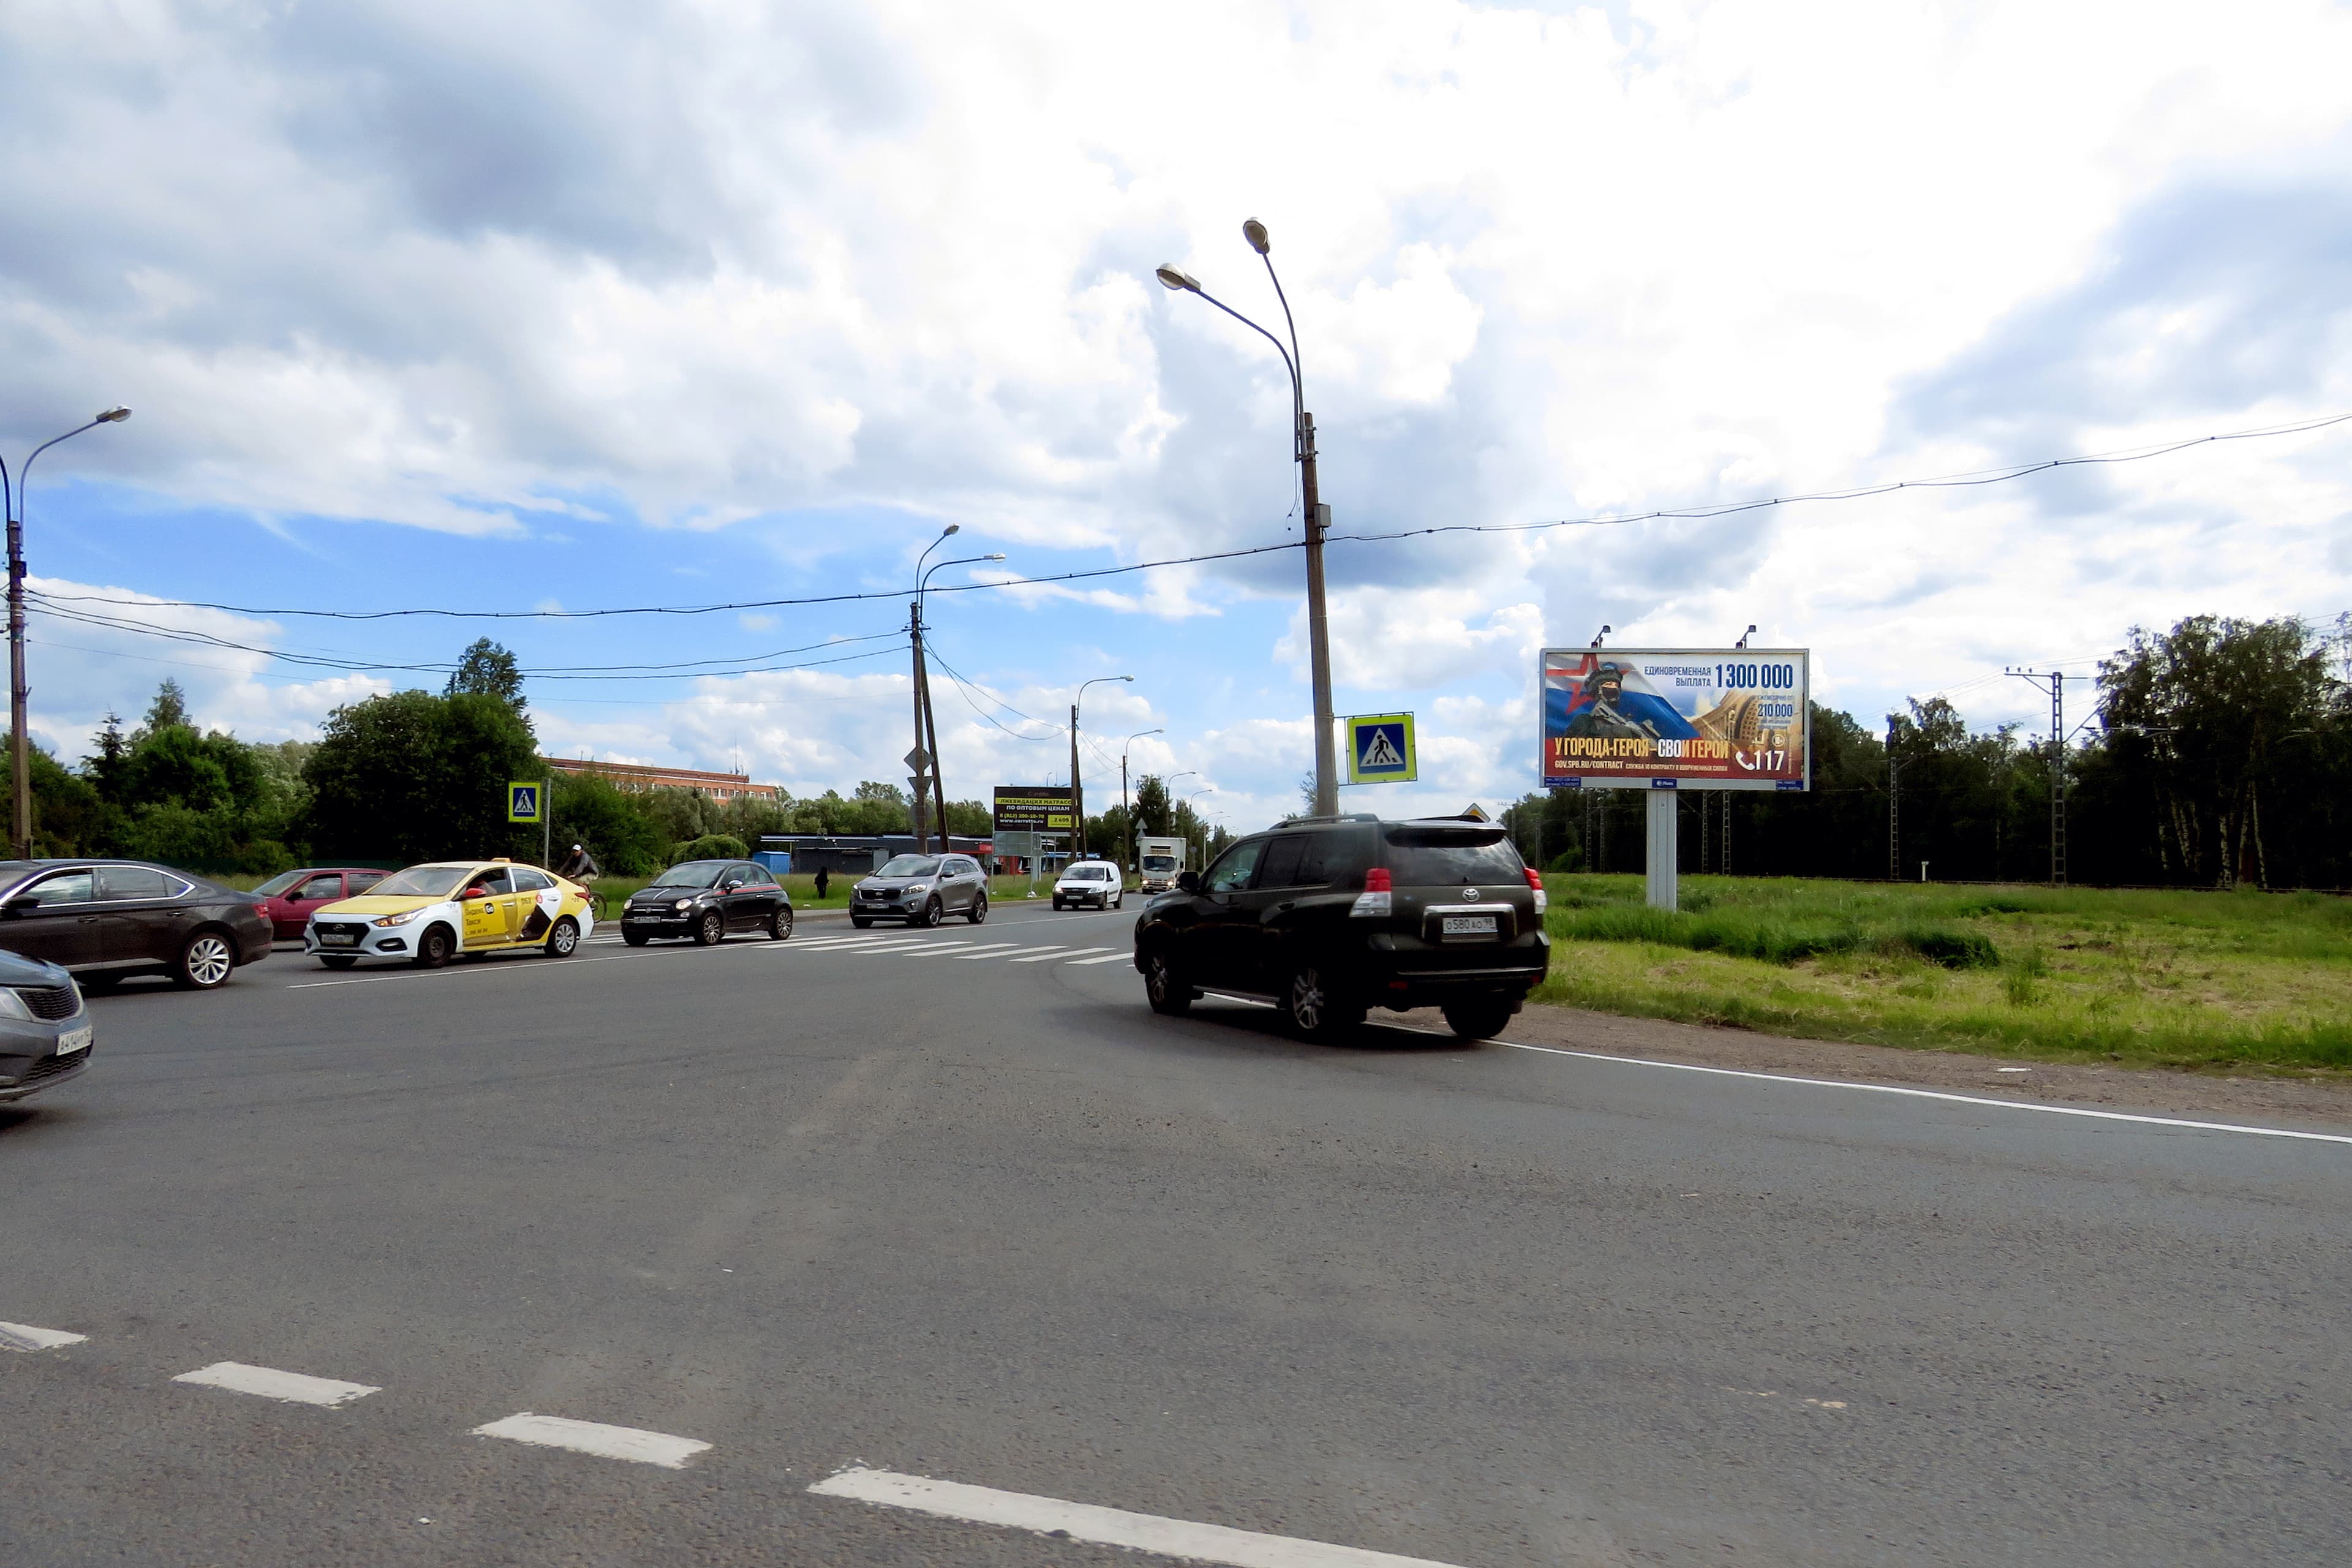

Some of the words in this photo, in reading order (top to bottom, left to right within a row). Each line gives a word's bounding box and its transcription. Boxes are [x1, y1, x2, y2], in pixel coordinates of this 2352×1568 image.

[1645, 666, 1711, 676] ЕДИНОВРЕМЕННАЯ
[1676, 677, 1711, 687] ВЫПЛАТА
[1758, 704, 1773, 717] 210
[1555, 737, 1562, 755] У
[1564, 737, 1649, 758] ГОРОДА-ГЕРОЯ
[1657, 739, 1690, 758] СВОИ
[1692, 739, 1729, 759] ГЕРОИ
[1555, 760, 1623, 769] GOV.SPB.RU/CONTRACT
[1754, 749, 1785, 771] 117
